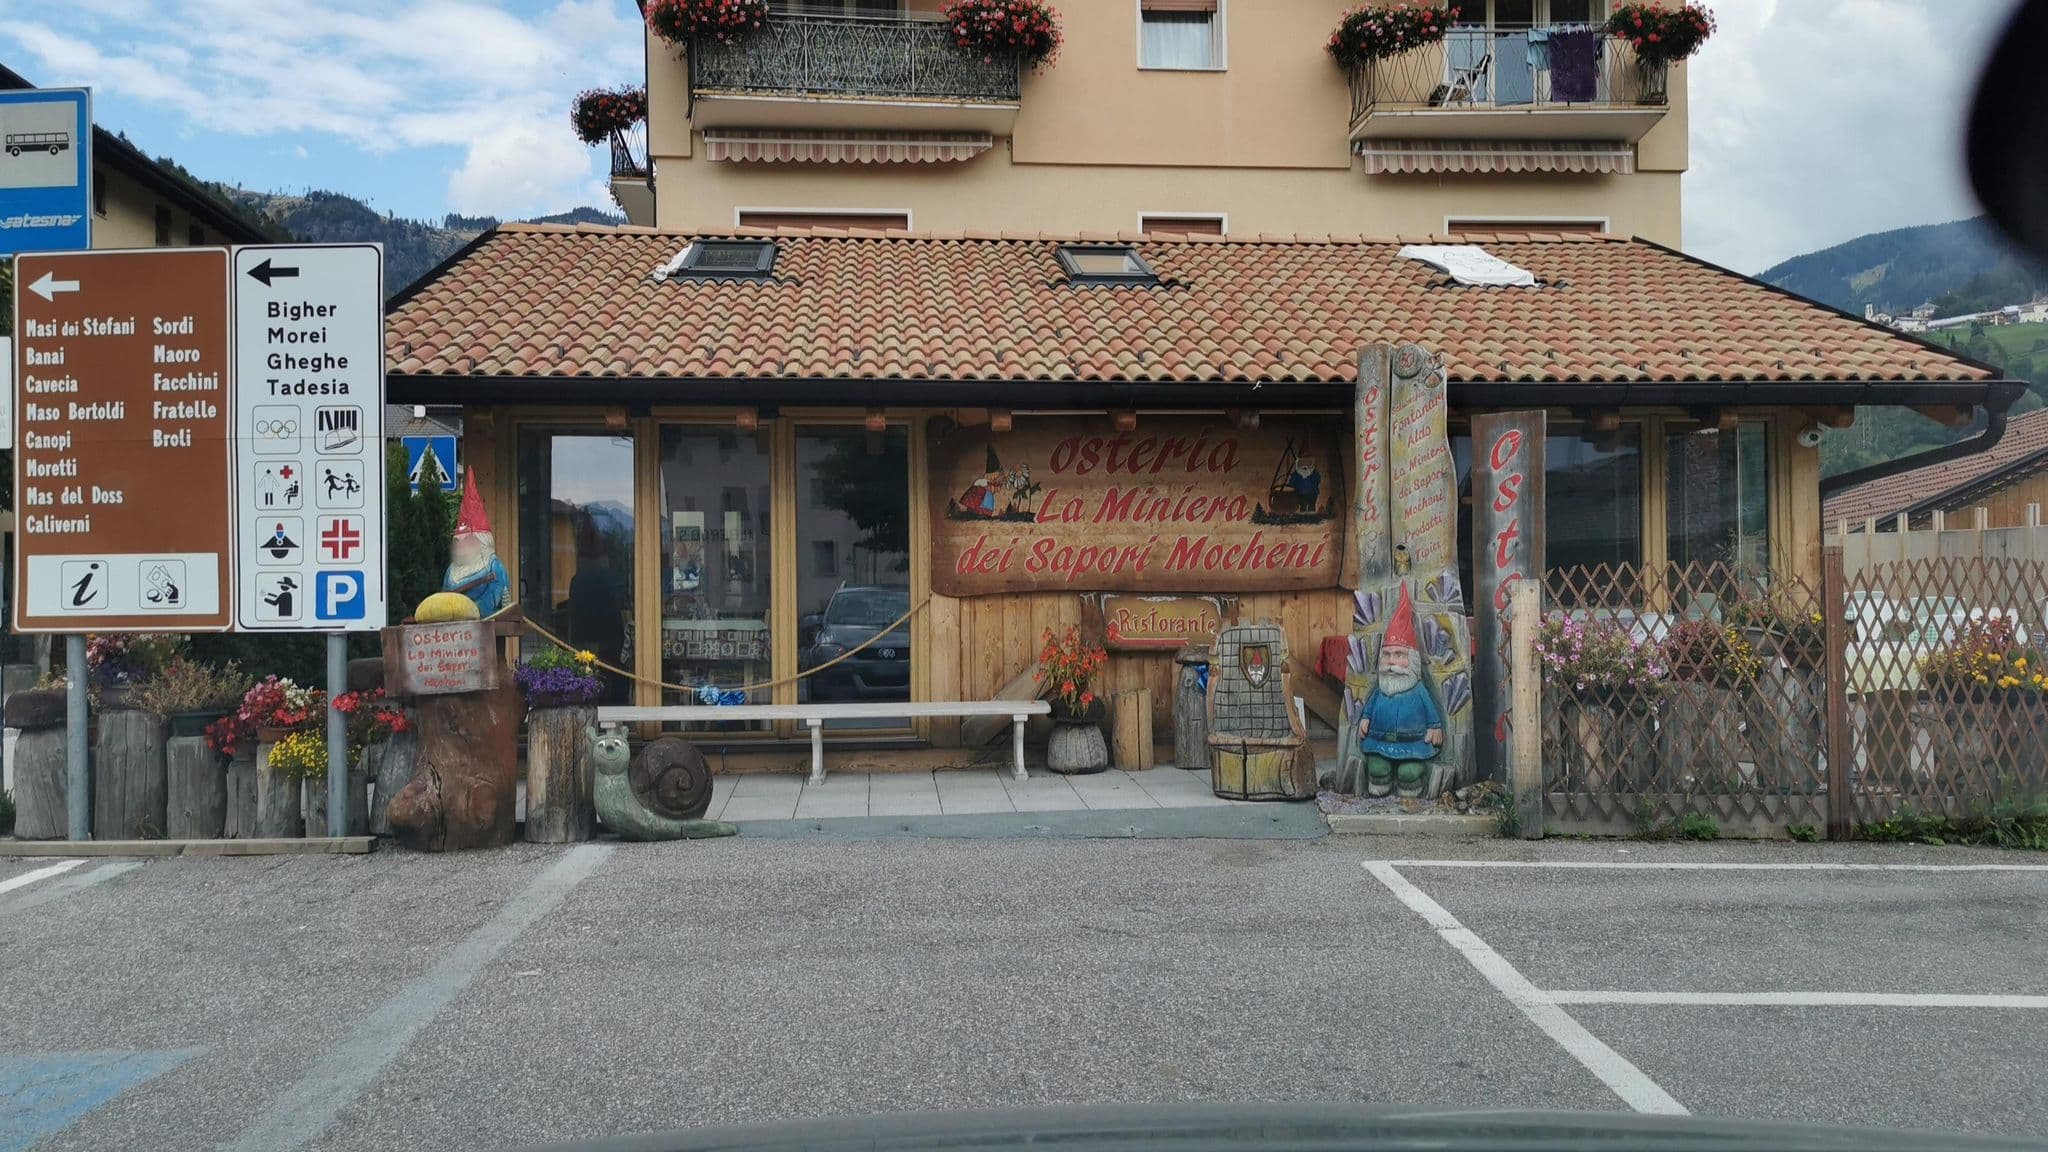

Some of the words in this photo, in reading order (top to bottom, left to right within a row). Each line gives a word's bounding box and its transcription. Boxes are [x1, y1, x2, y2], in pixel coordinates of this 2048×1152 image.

[267, 301, 337, 321] Bigher
[26, 319, 57, 337] Masi
[61, 321, 79, 336] dei
[83, 317, 135, 336] Stefani
[153, 316, 194, 335] Sordi
[267, 327, 327, 343] Morei
[26, 347, 65, 366] Banai
[153, 345, 200, 363] Maoro
[267, 353, 349, 372] Gheghe
[26, 375, 78, 393] Cavecia
[153, 372, 218, 391] Facchini
[267, 379, 350, 395] Tadesia
[26, 403, 60, 422] Maso
[68, 402, 125, 420] Bertoldi
[153, 401, 217, 420] Fratelle
[26, 431, 71, 450] Canopi
[153, 429, 191, 447] Broli
[26, 458, 77, 477] Moretti
[26, 487, 56, 506] Mas
[61, 486, 83, 505] del
[92, 486, 123, 505] Doss
[1034, 488, 1086, 525] La
[1093, 484, 1250, 524] Miniera
[26, 515, 91, 534] Caliverni
[955, 534, 1021, 576] dei
[1024, 534, 1159, 583] Sapori
[1164, 530, 1332, 572] Mocheni
[1415, 540, 1442, 562] Tipici
[327, 574, 358, 616] P
[1116, 606, 1217, 634] Ristorante
[412, 628, 473, 646] Osteria
